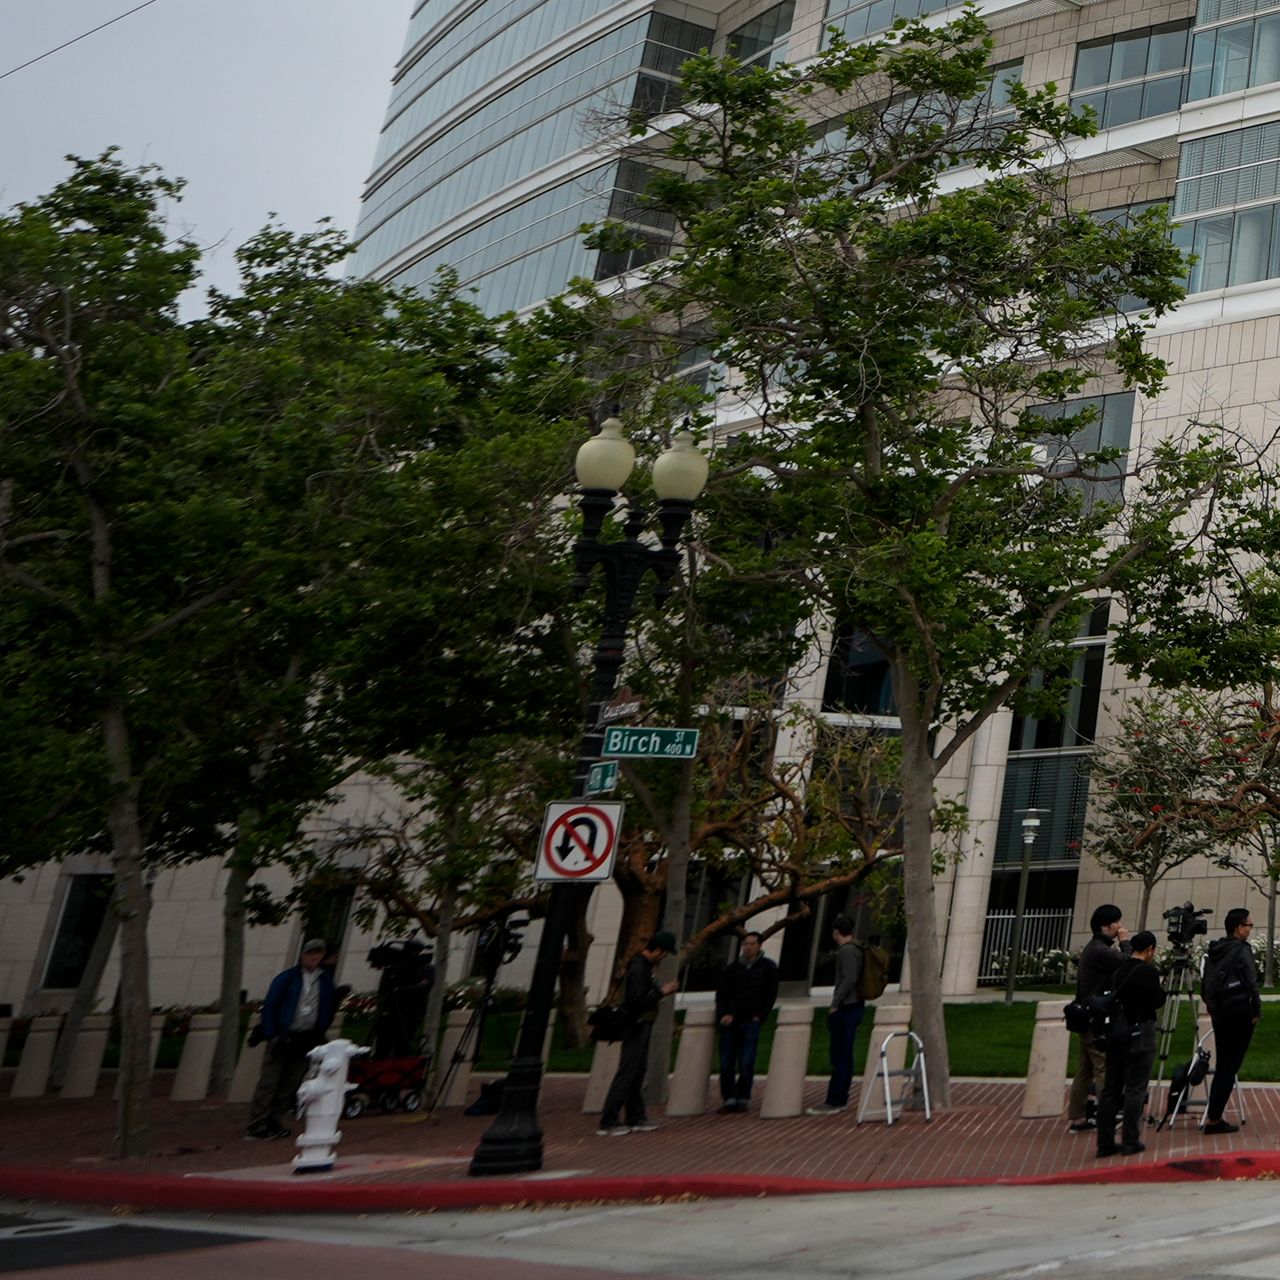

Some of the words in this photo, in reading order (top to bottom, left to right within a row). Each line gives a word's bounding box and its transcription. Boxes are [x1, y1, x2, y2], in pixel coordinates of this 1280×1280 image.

[608, 731, 661, 753] Birch
[675, 732, 685, 743] ST
[664, 743, 682, 755] 400
